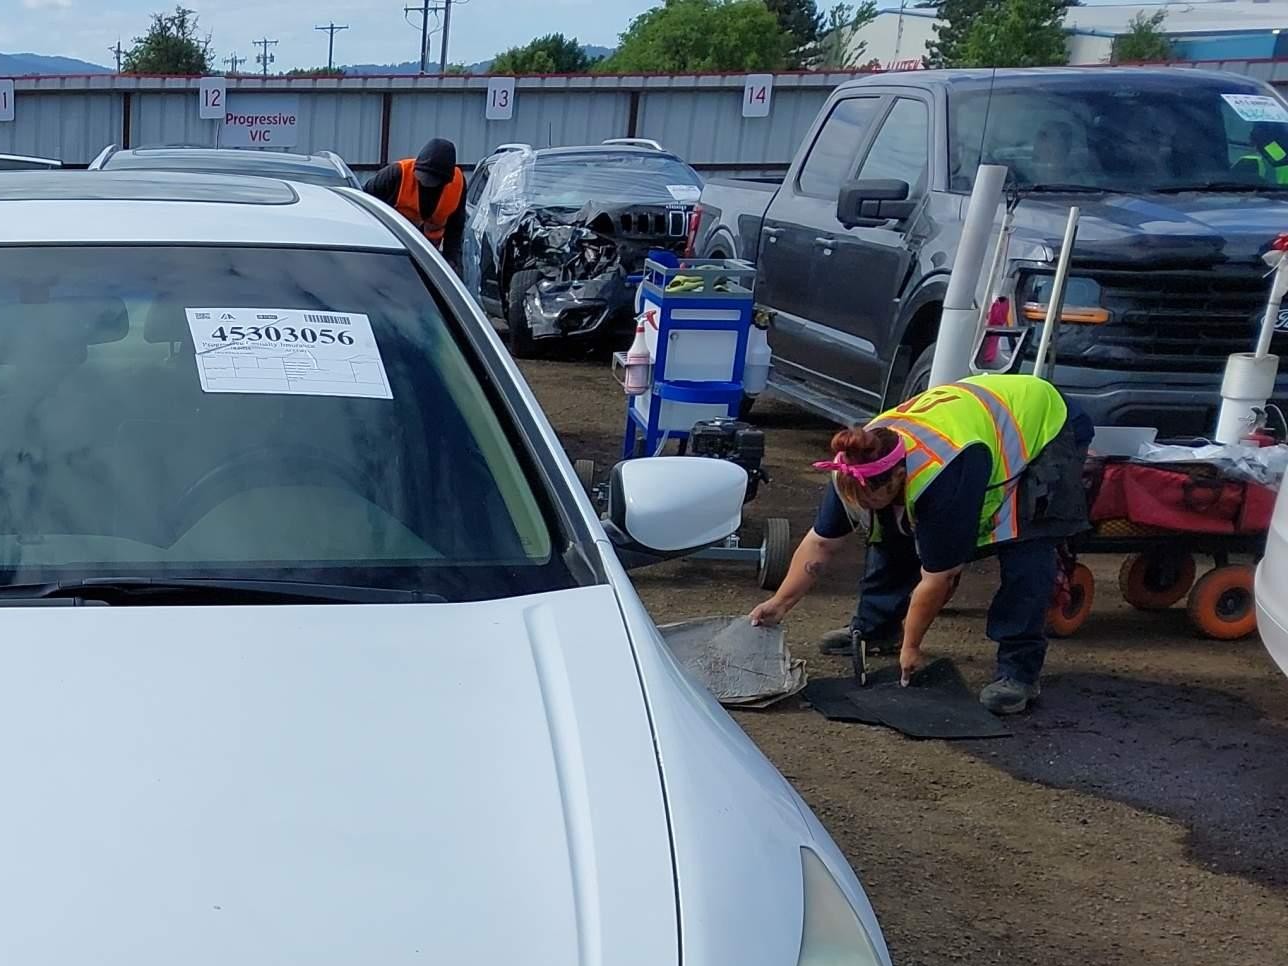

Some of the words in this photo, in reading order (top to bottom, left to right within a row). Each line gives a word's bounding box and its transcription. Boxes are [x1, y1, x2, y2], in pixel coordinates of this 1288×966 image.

[204, 89, 221, 107] 12
[492, 89, 509, 107] 13
[749, 86, 766, 104] 14
[225, 112, 296, 127] Progressive
[249, 129, 271, 142] VIC
[211, 326, 355, 346] 45303056
